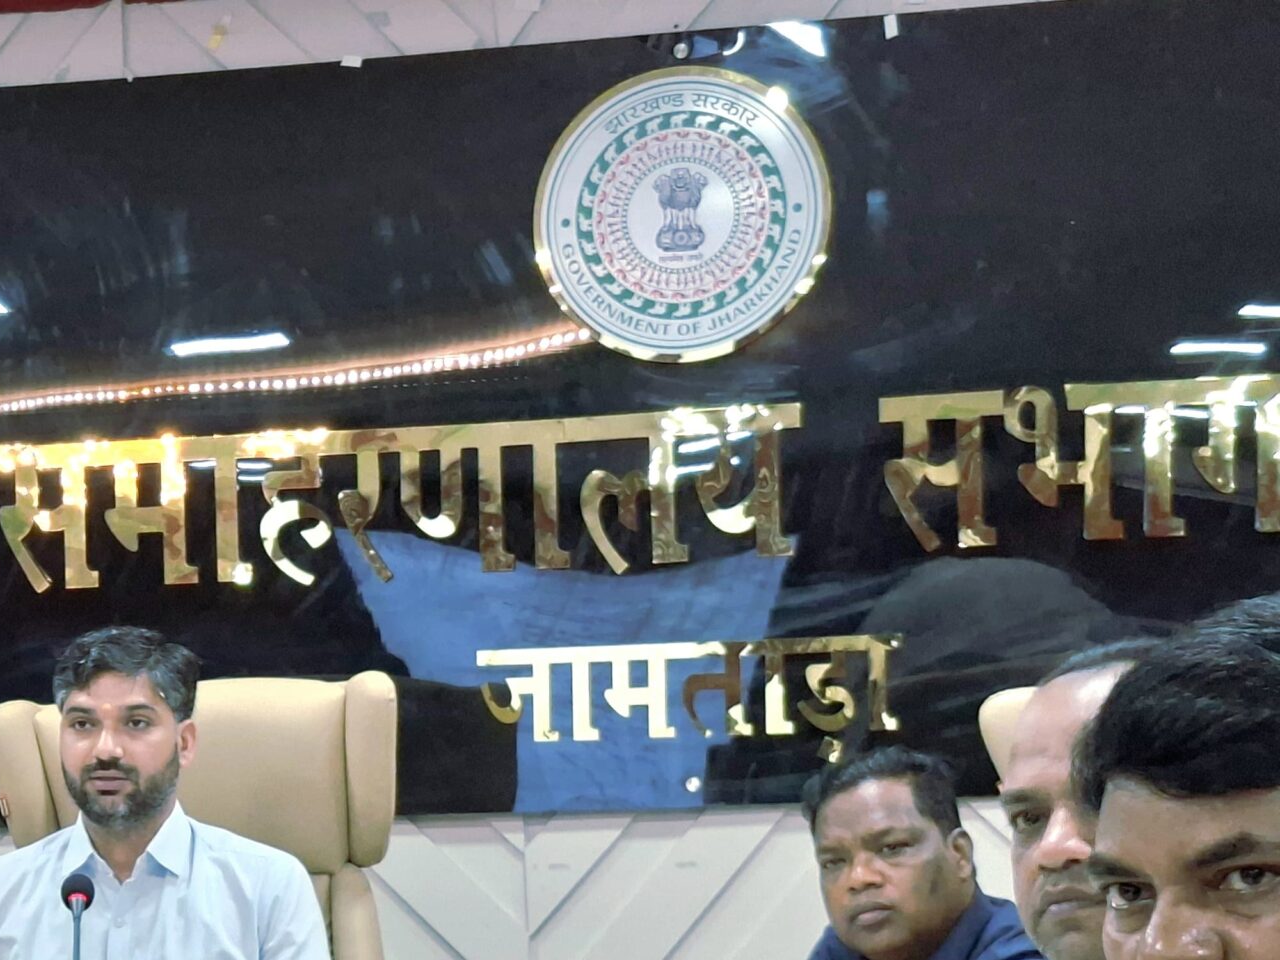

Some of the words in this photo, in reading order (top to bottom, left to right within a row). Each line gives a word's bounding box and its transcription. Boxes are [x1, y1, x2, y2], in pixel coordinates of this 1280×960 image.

[691, 93, 759, 128] सरकार
[561, 242, 672, 337] GOVERNMENT
[677, 322, 702, 337] OF
[707, 228, 802, 332] JHARKHAND
[476, 634, 904, 763] जामताड़ा
